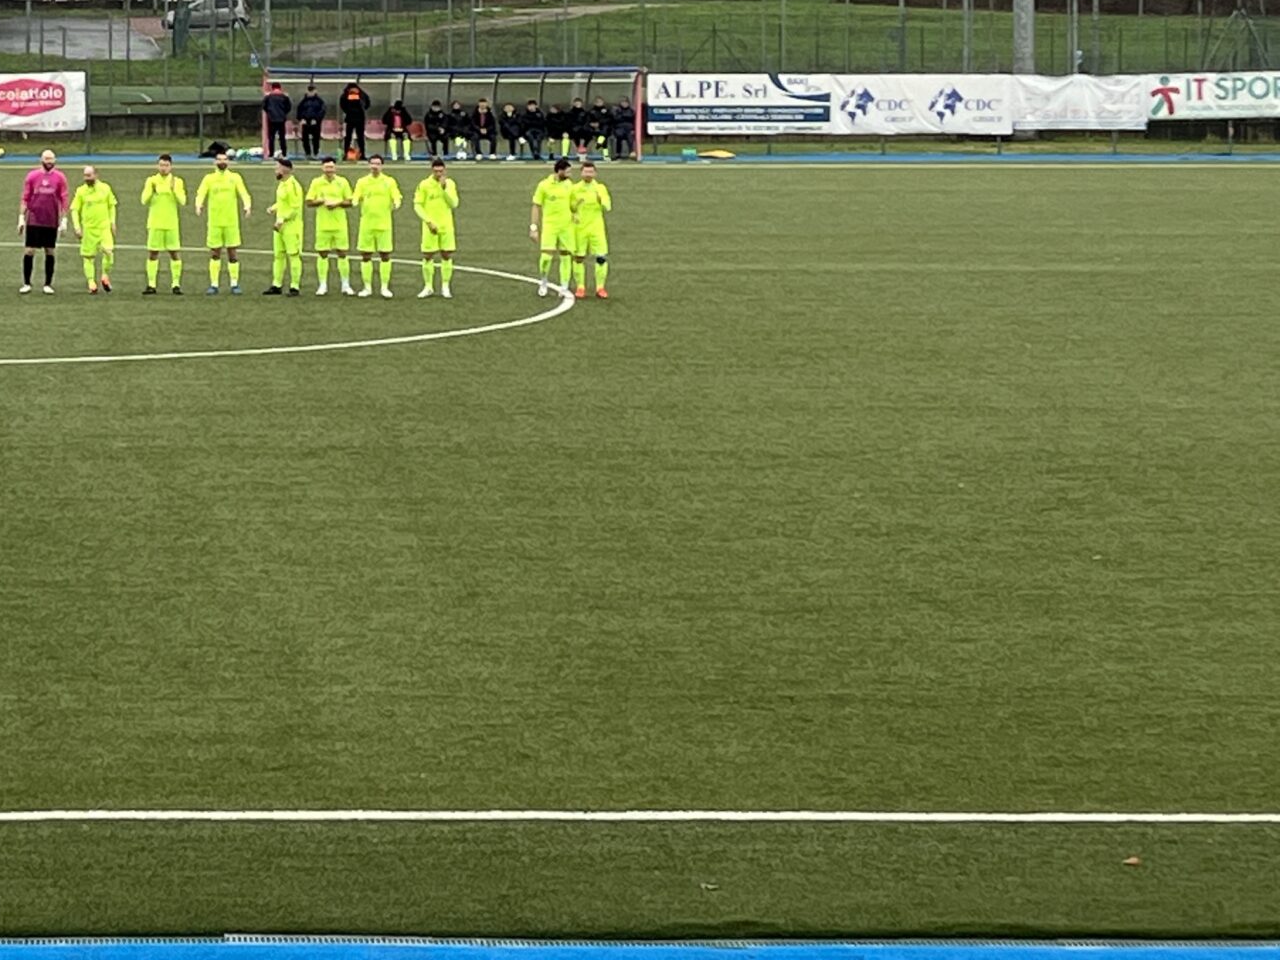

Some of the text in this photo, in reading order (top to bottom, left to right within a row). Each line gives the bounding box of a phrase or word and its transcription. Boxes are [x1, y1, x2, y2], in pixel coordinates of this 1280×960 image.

[742, 83, 767, 99] Srl
[1186, 78, 1207, 100] IT
[875, 98, 910, 111] CDC
[964, 98, 1000, 111] CDC
